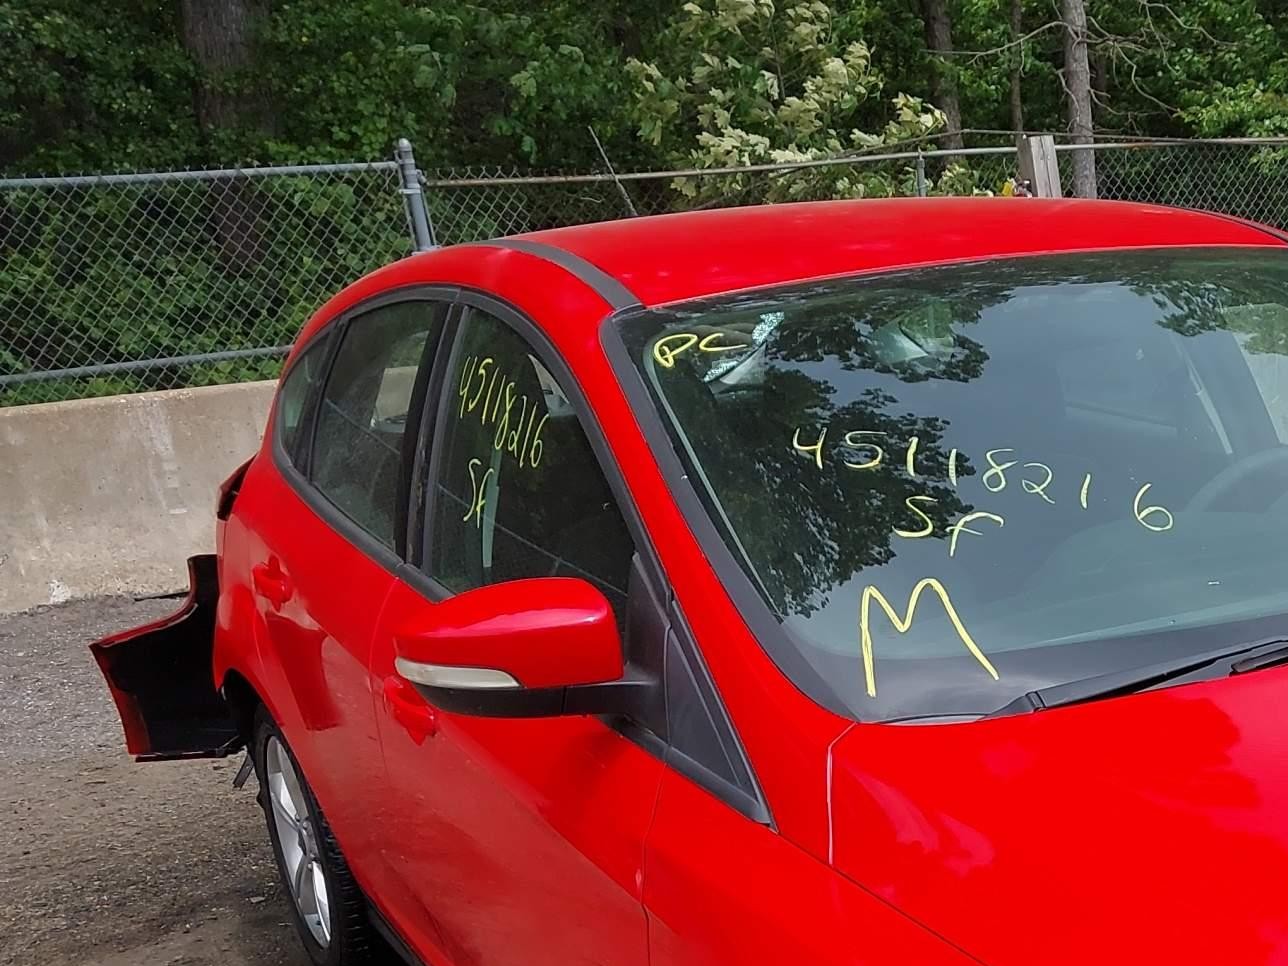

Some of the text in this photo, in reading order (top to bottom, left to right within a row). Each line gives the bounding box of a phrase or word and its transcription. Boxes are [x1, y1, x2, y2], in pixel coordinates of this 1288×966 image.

[460, 355, 550, 469] 45118216
[793, 426, 1173, 531] 45118216
[859, 578, 999, 697] M
